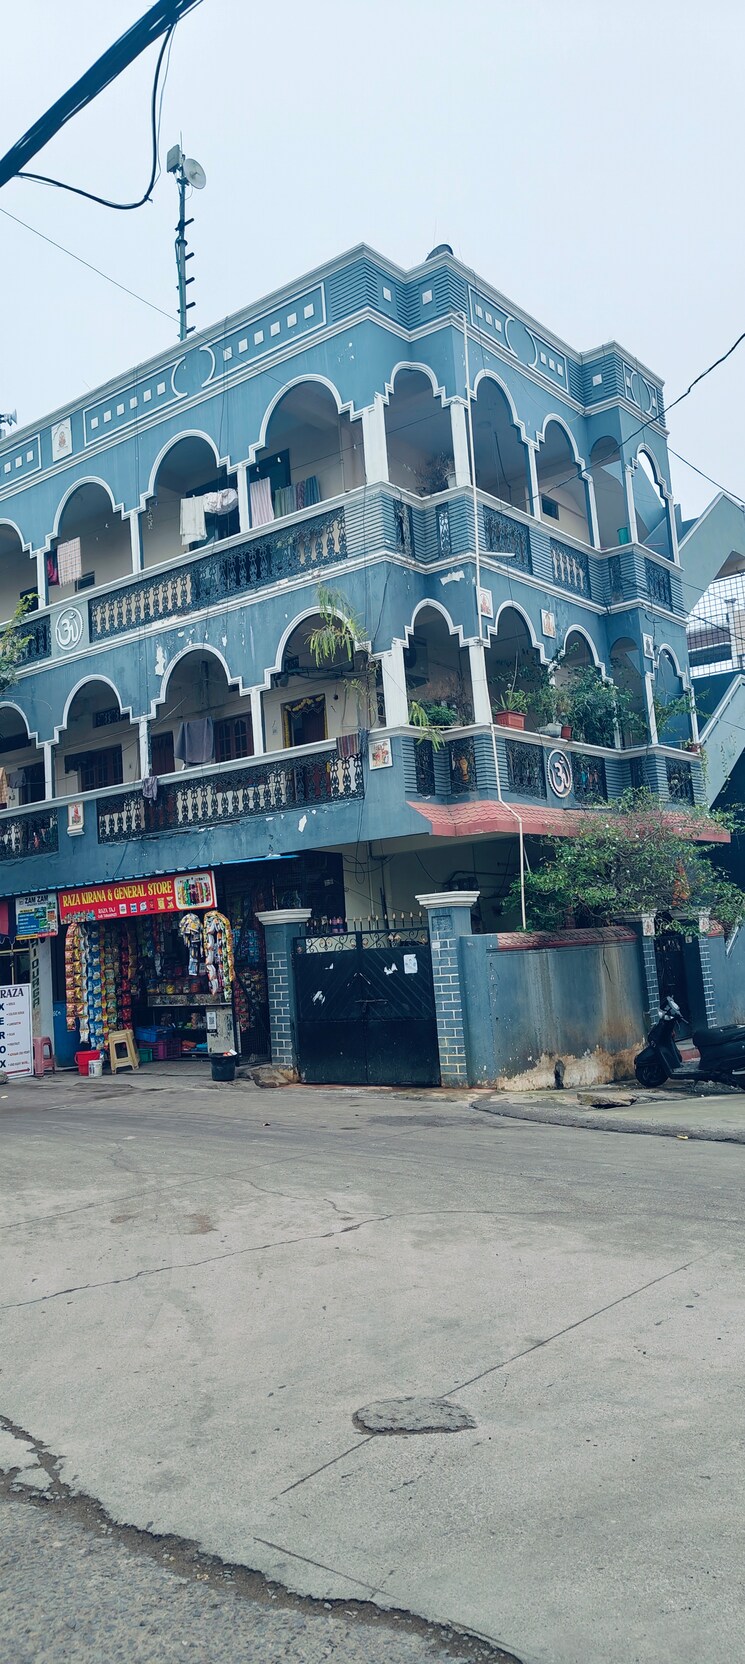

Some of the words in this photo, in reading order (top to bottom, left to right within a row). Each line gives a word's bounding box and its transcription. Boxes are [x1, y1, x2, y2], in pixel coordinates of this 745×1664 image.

[62, 893, 81, 907] RAZA
[81, 889, 106, 904] KIRANA
[107, 888, 113, 901] &
[114, 884, 146, 900] GENERAL
[147, 880, 173, 895] STORE
[25, 896, 36, 904] ZAM
[0, 988, 24, 999] RAZA
